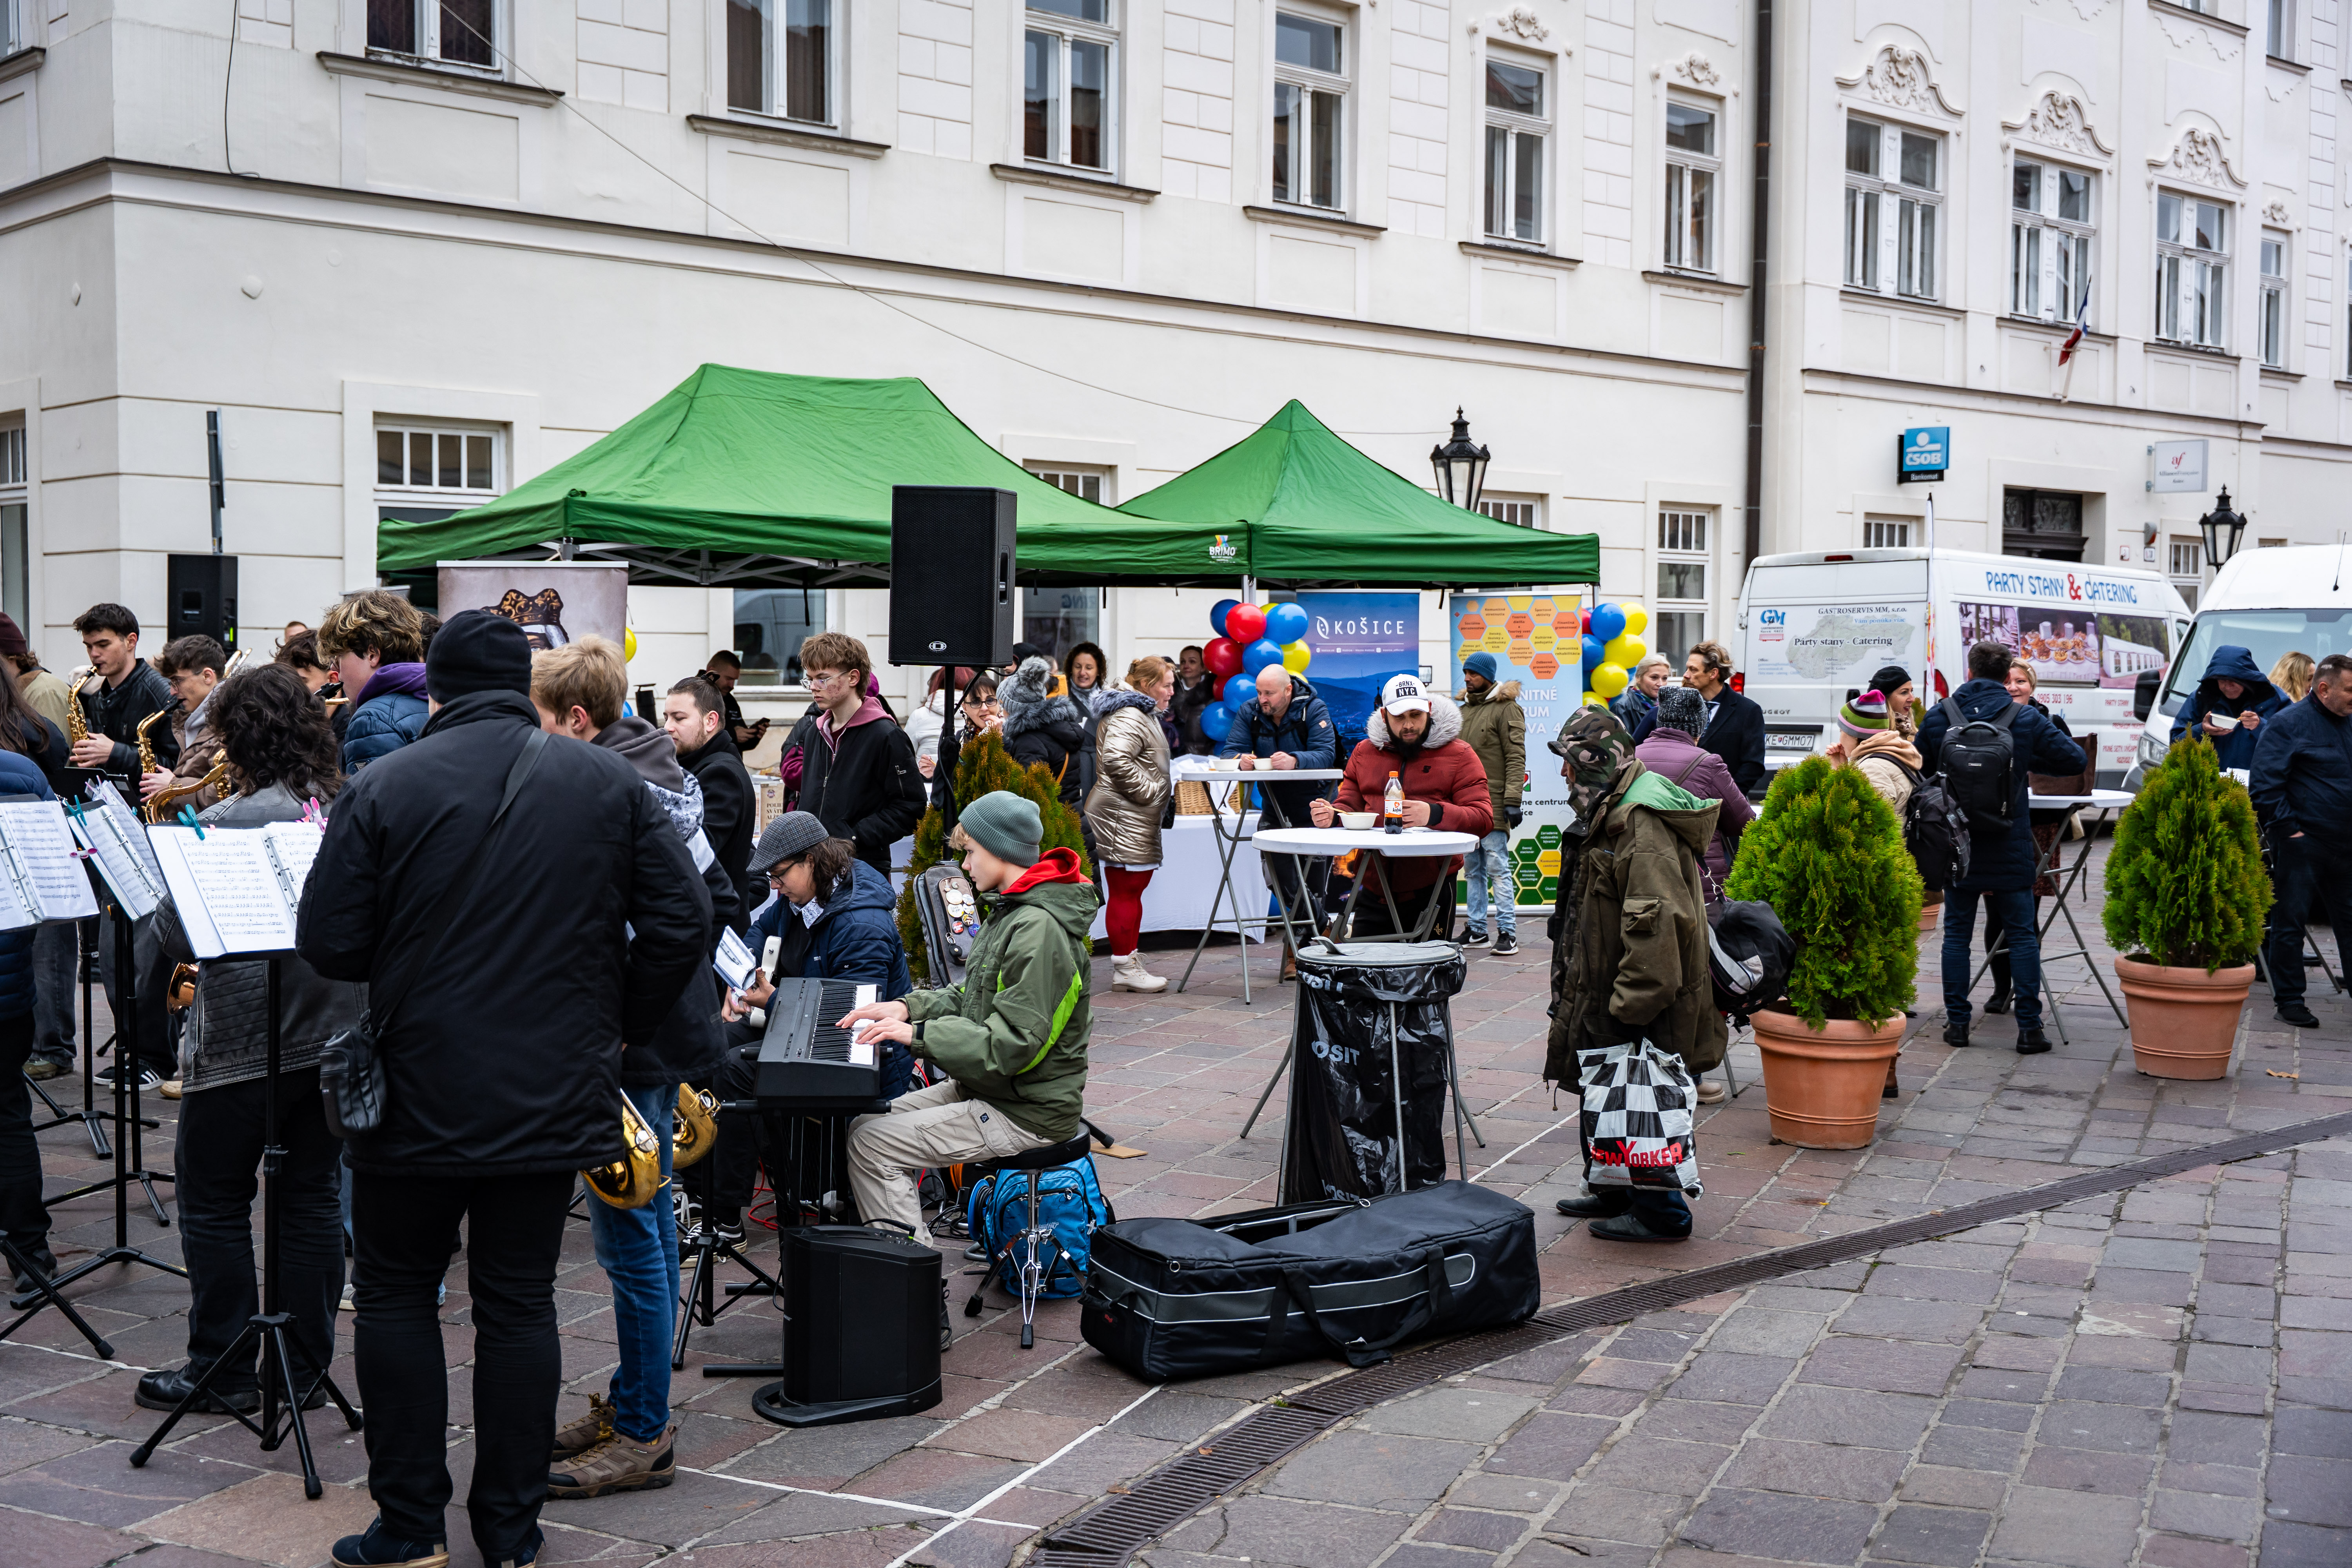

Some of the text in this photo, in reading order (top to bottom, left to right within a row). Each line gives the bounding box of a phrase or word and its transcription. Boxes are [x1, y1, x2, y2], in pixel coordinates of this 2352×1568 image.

[1906, 452, 1941, 465] ČSOB
[1209, 546, 1236, 556] BRIMO
[1986, 572, 2137, 604] PARTY STANY & CATERING
[1335, 617, 1404, 635] KOŠICE
[1820, 639, 1844, 647] stany
[1853, 637, 1892, 646] Catering
[1398, 688, 1415, 696] NYC
[1516, 686, 1557, 701] NITNÉ
[2052, 694, 2061, 703] 303
[2064, 694, 2073, 704] 196
[1522, 706, 1549, 717] RUM
[1526, 723, 1546, 734] VA
[1766, 735, 1777, 745] KE
